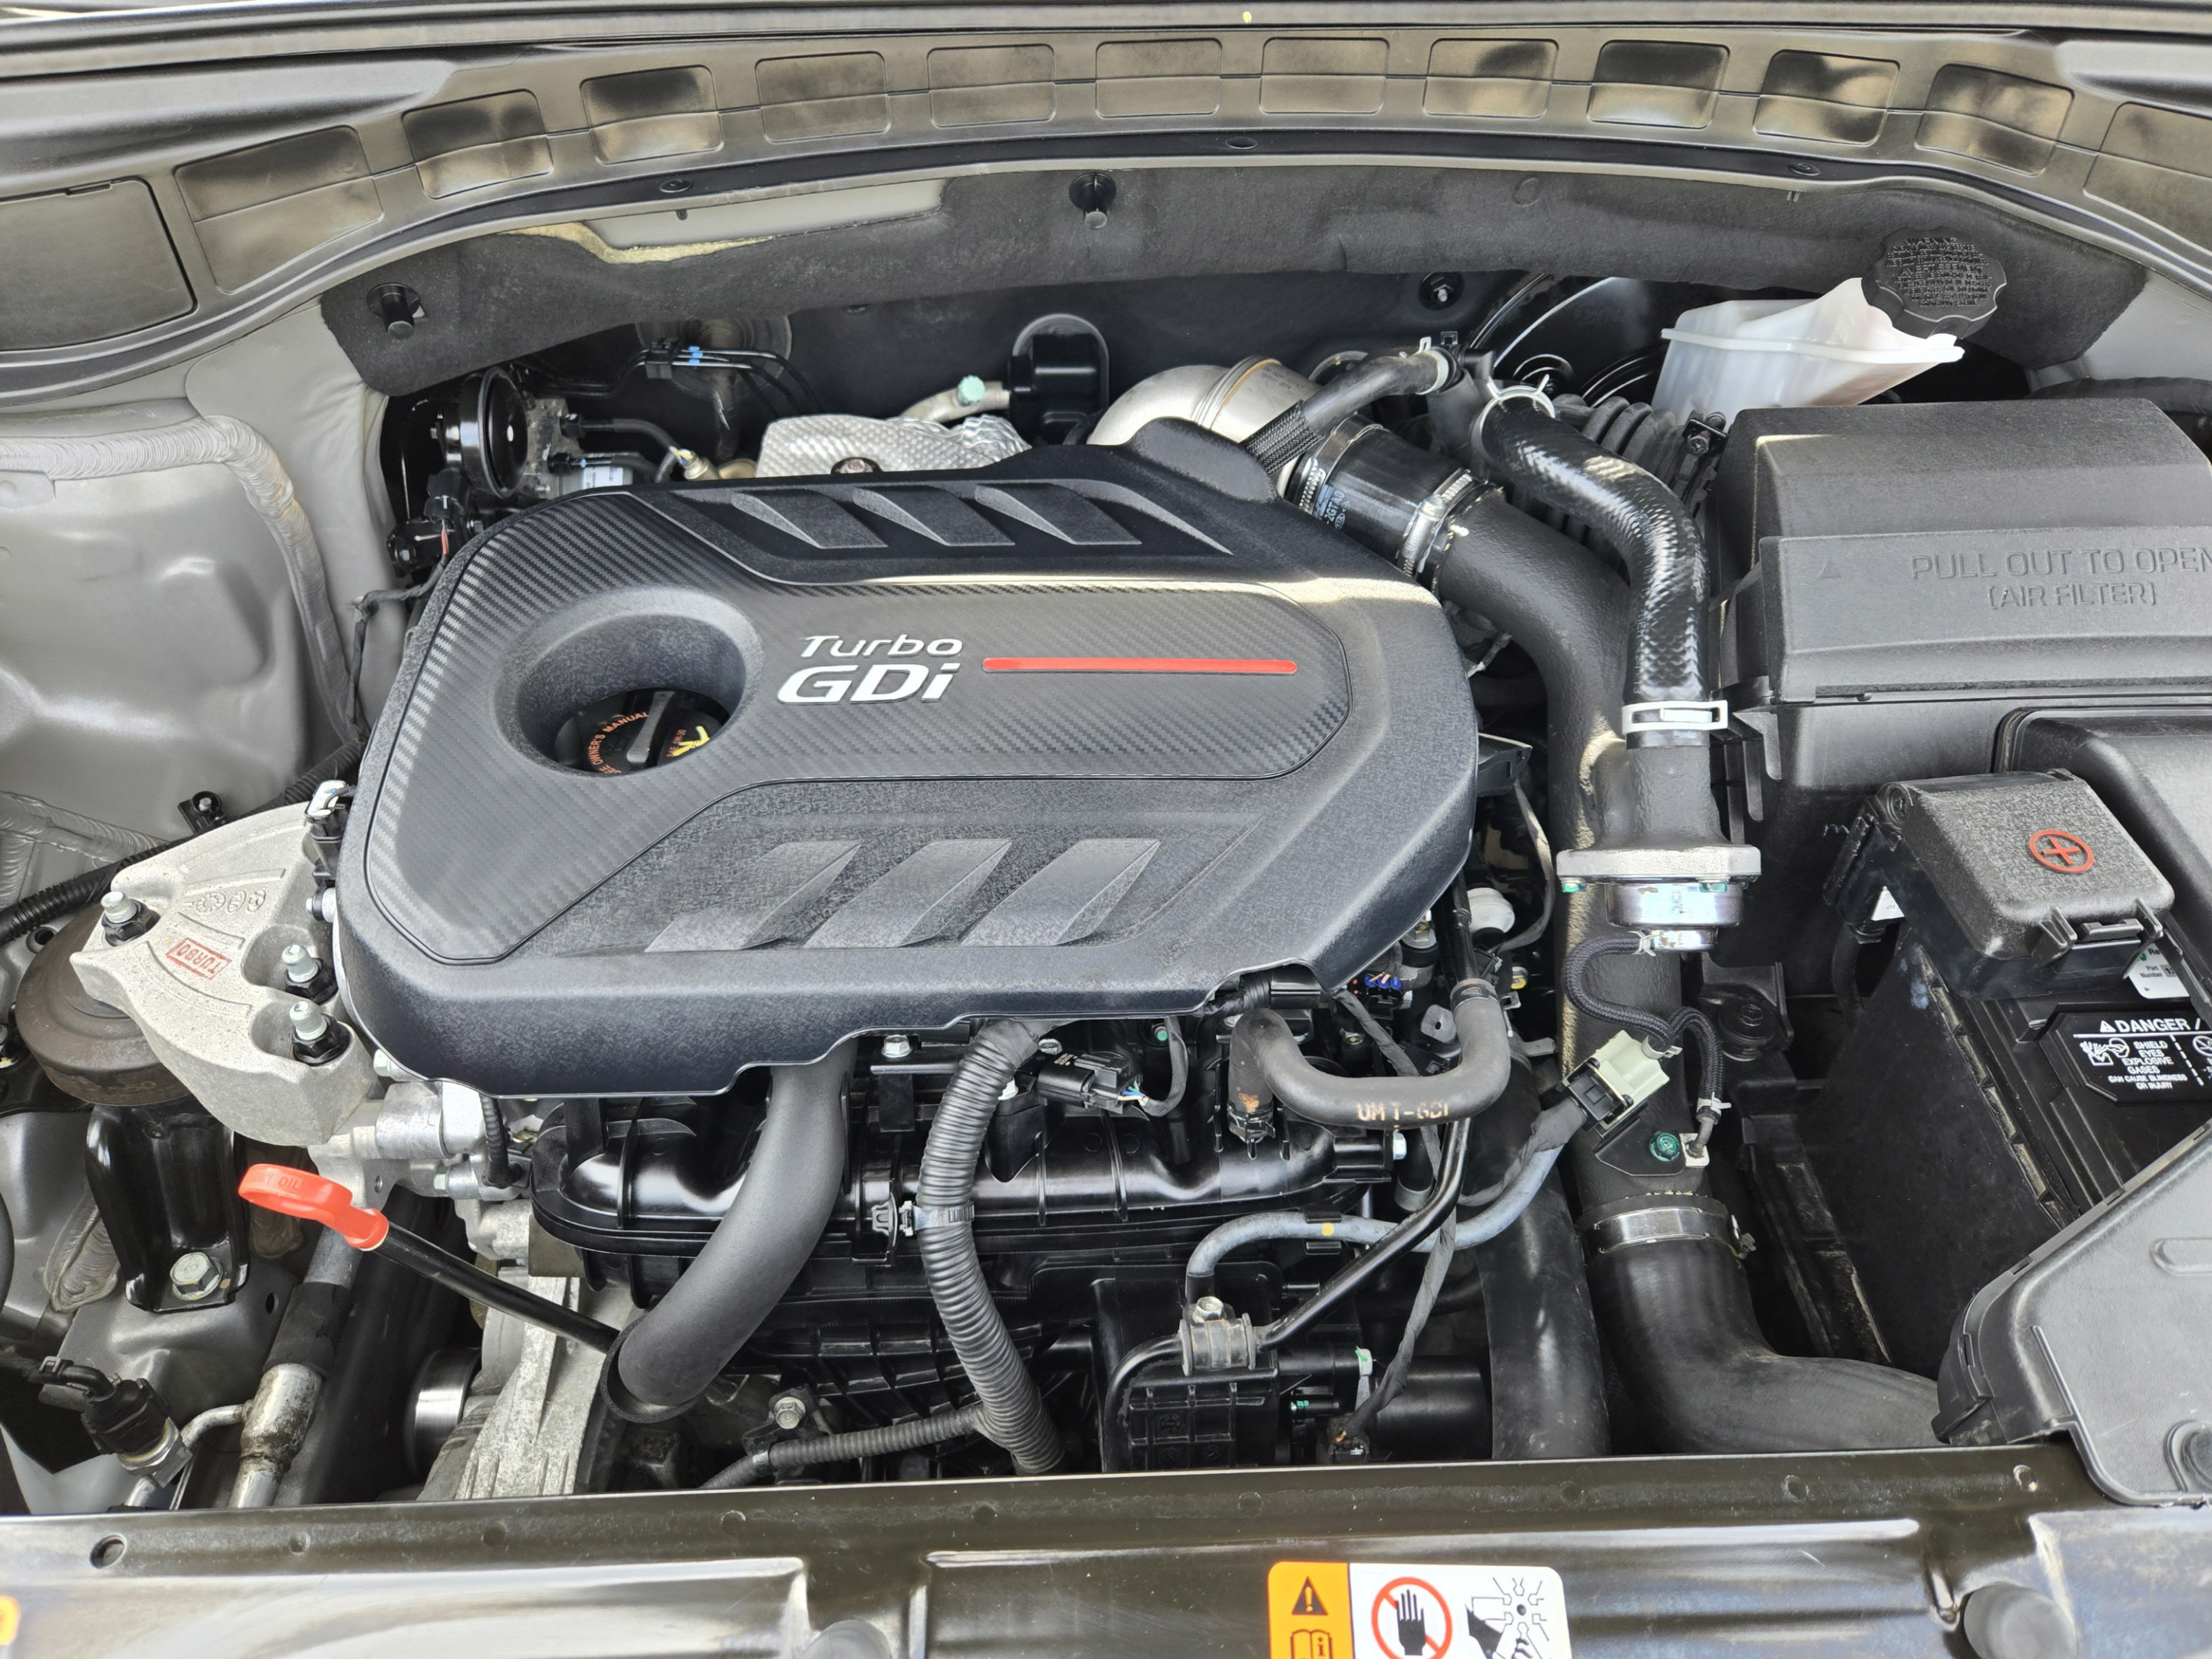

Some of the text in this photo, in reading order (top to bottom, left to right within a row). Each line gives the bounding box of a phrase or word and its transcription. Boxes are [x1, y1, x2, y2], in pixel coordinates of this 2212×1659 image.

[1911, 547, 2212, 579] PULL OUT TO OPEN
[800, 634, 962, 657] Turbo
[777, 662, 960, 705] GDi
[588, 733, 605, 765] OWNER'S
[602, 711, 649, 733] MANUAL
[177, 944, 221, 974] TURBO
[2114, 1018, 2191, 1033] DANGER
[2133, 1041, 2168, 1050] SHIELD
[2121, 1057, 2174, 1066] EXPLOSIVE
[2127, 1065, 2161, 1075] GASES
[1356, 1101, 1386, 1121] UM
[278, 1176, 300, 1190] OIL
